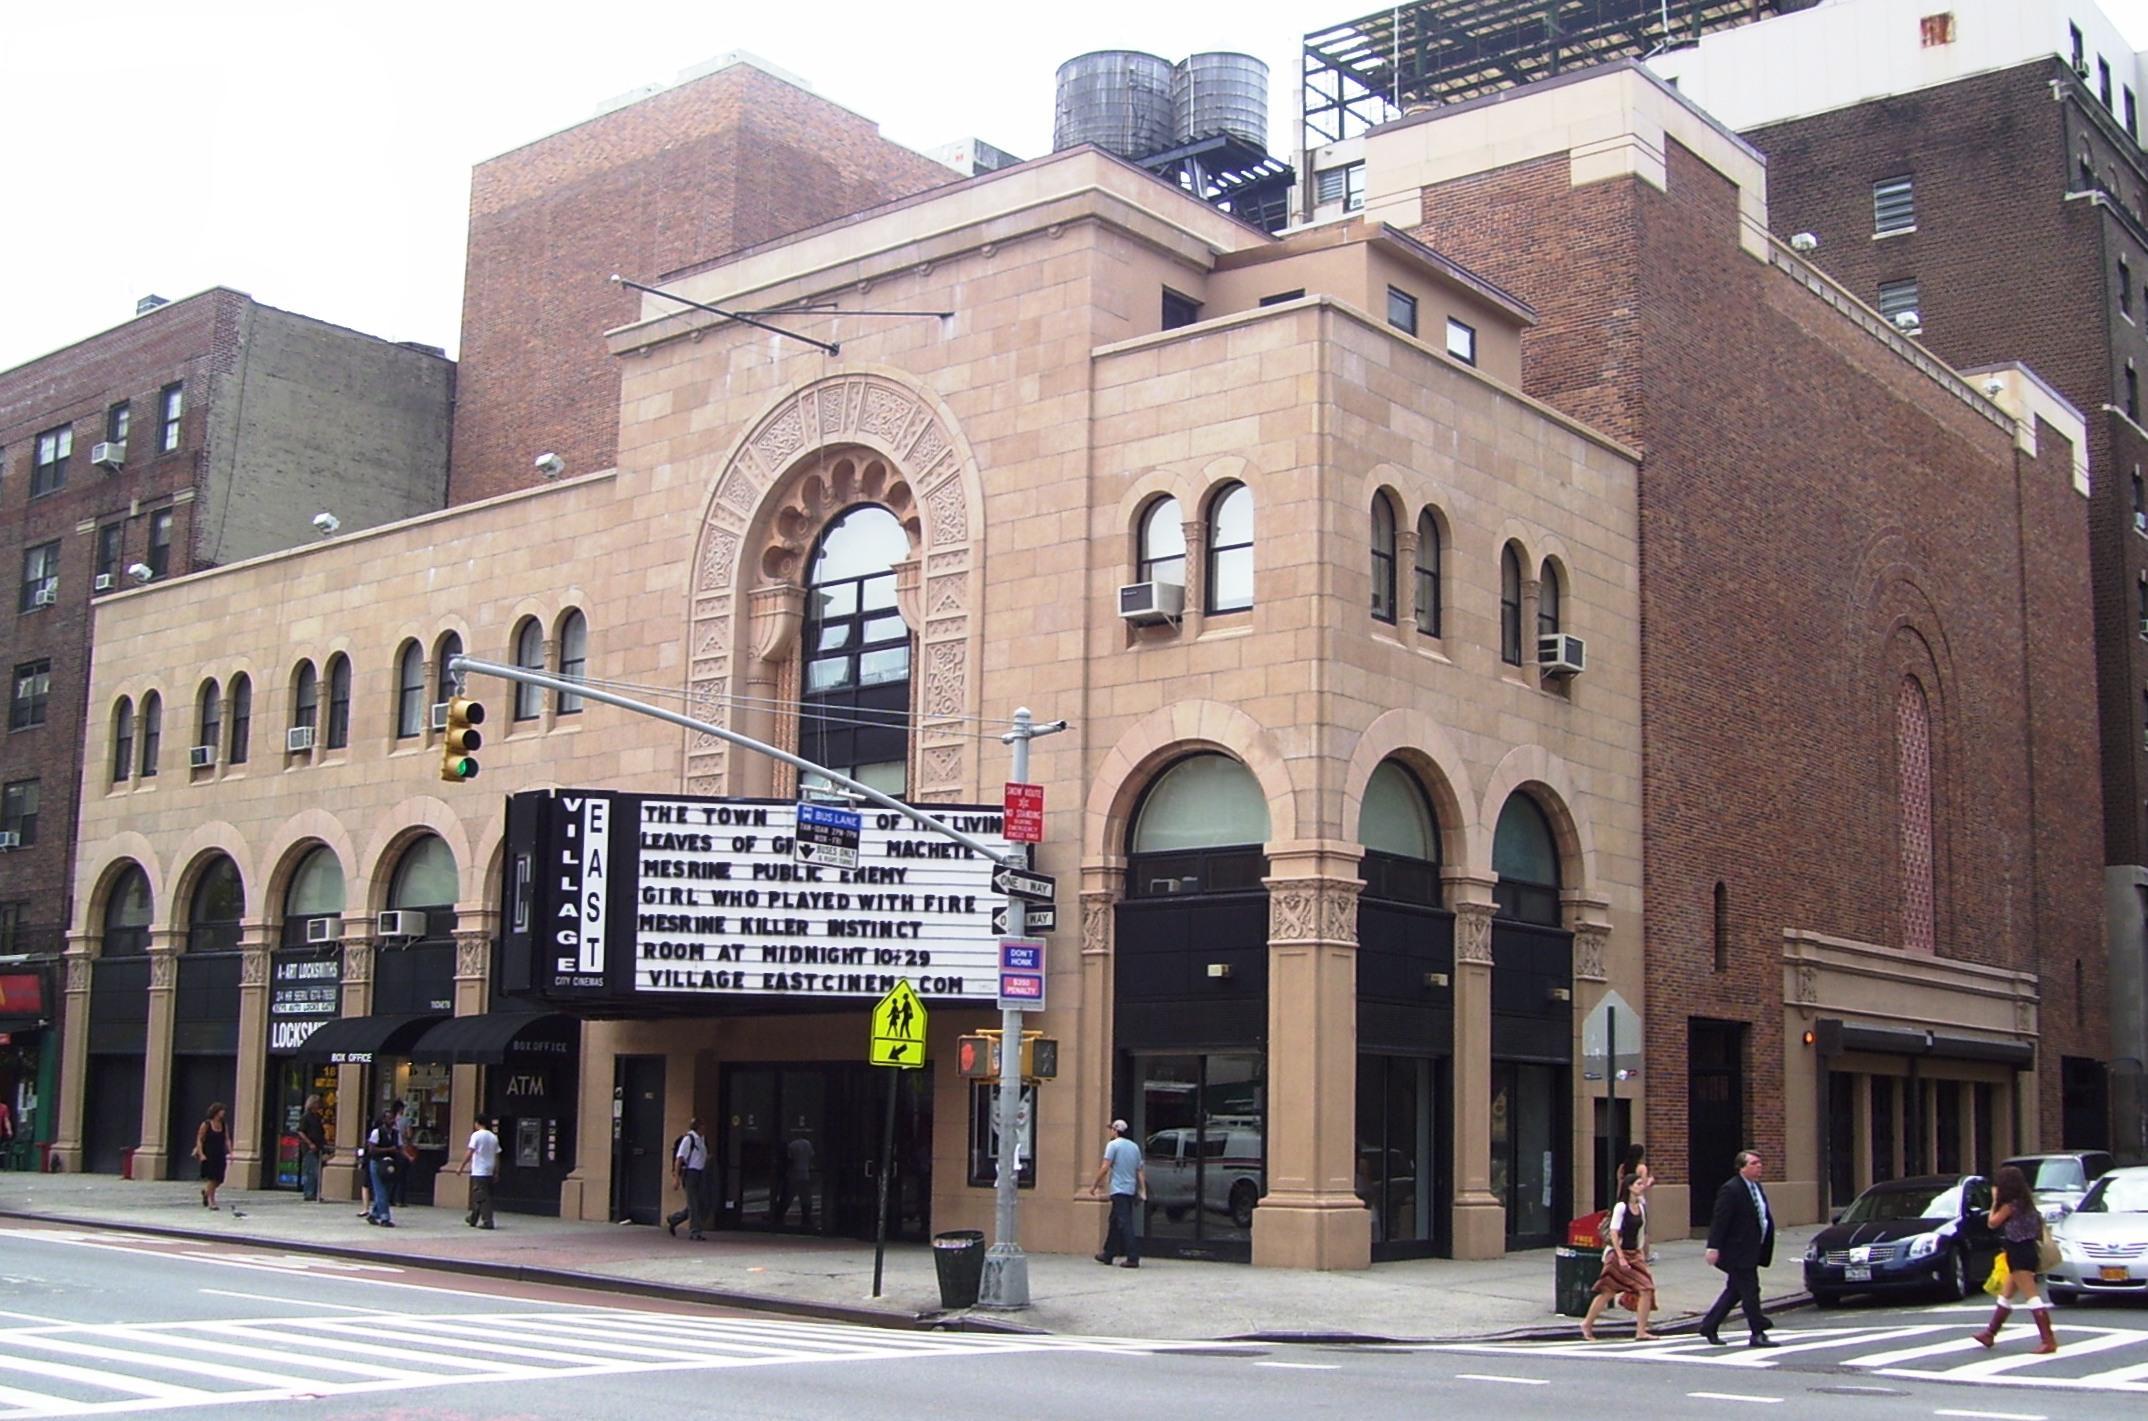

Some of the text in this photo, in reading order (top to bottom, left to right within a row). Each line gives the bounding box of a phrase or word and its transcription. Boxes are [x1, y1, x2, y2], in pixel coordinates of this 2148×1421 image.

[644, 805, 767, 827] THE TOWN
[815, 811, 858, 826] BUS LANE
[876, 813, 901, 830] OF
[640, 832, 712, 852] LEAVES
[732, 835, 757, 853] OF
[816, 845, 856, 858] BUSES ONLY
[886, 840, 974, 859] MACHETE
[644, 859, 909, 884] MESRINE PUBLIC ENEMY
[556, 797, 583, 972] VILLAGE
[586, 804, 603, 967] EAST
[1000, 874, 1048, 894] ONE WAY
[642, 886, 976, 914] GIRL WHO PLAYED WITH FIRE
[639, 913, 923, 939] MESRINE KILLER INSTINCT
[1030, 914, 1048, 924] WAY
[643, 941, 704, 961] ROOM
[717, 944, 745, 962] AT
[762, 945, 867, 965] MIDNIGHT
[1010, 949, 1034, 958] DON'T
[1010, 958, 1033, 966] HONK
[299, 961, 338, 979] LOCKSMITHS
[555, 976, 604, 987] CITY CINEMAS
[649, 969, 963, 994] VILLAGE EASTCINEM.COM
[513, 1040, 567, 1052] BOX OFFICE
[331, 1053, 372, 1063] BOX OFFICE
[506, 1075, 545, 1096] ATM
